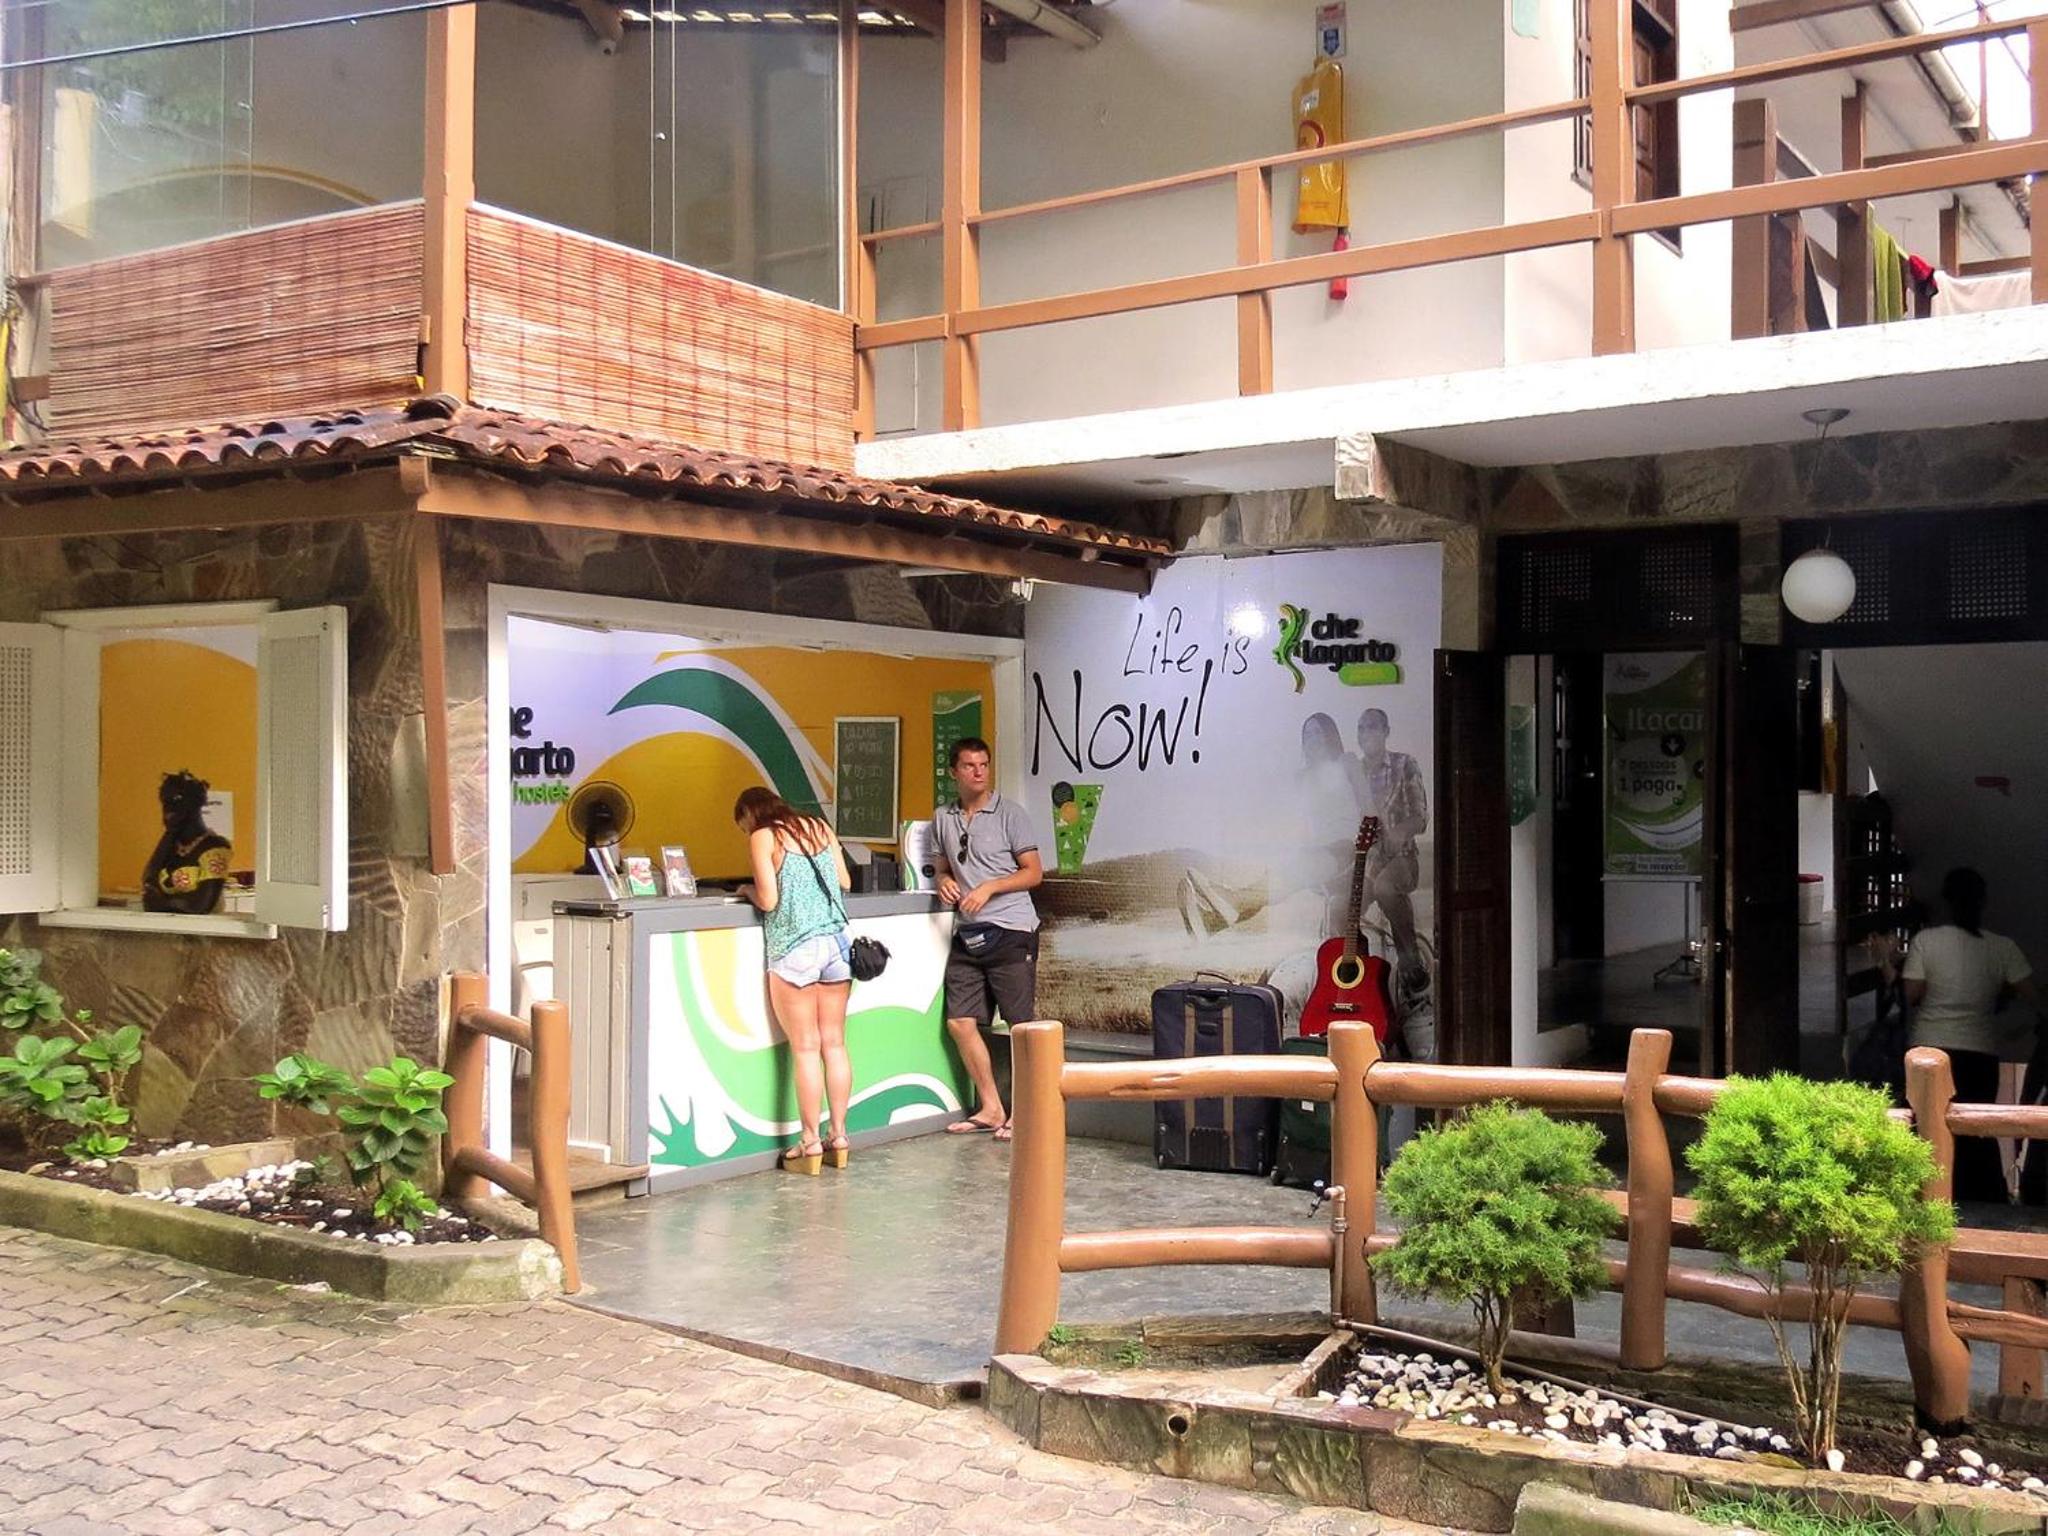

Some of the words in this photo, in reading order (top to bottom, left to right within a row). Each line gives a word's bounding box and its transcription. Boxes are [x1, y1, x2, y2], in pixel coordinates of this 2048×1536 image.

[1123, 606, 1200, 678] Life
[1219, 631, 1251, 676] is
[1311, 613, 1361, 640] che
[1302, 638, 1397, 673] lagarto
[510, 740, 576, 778] arto
